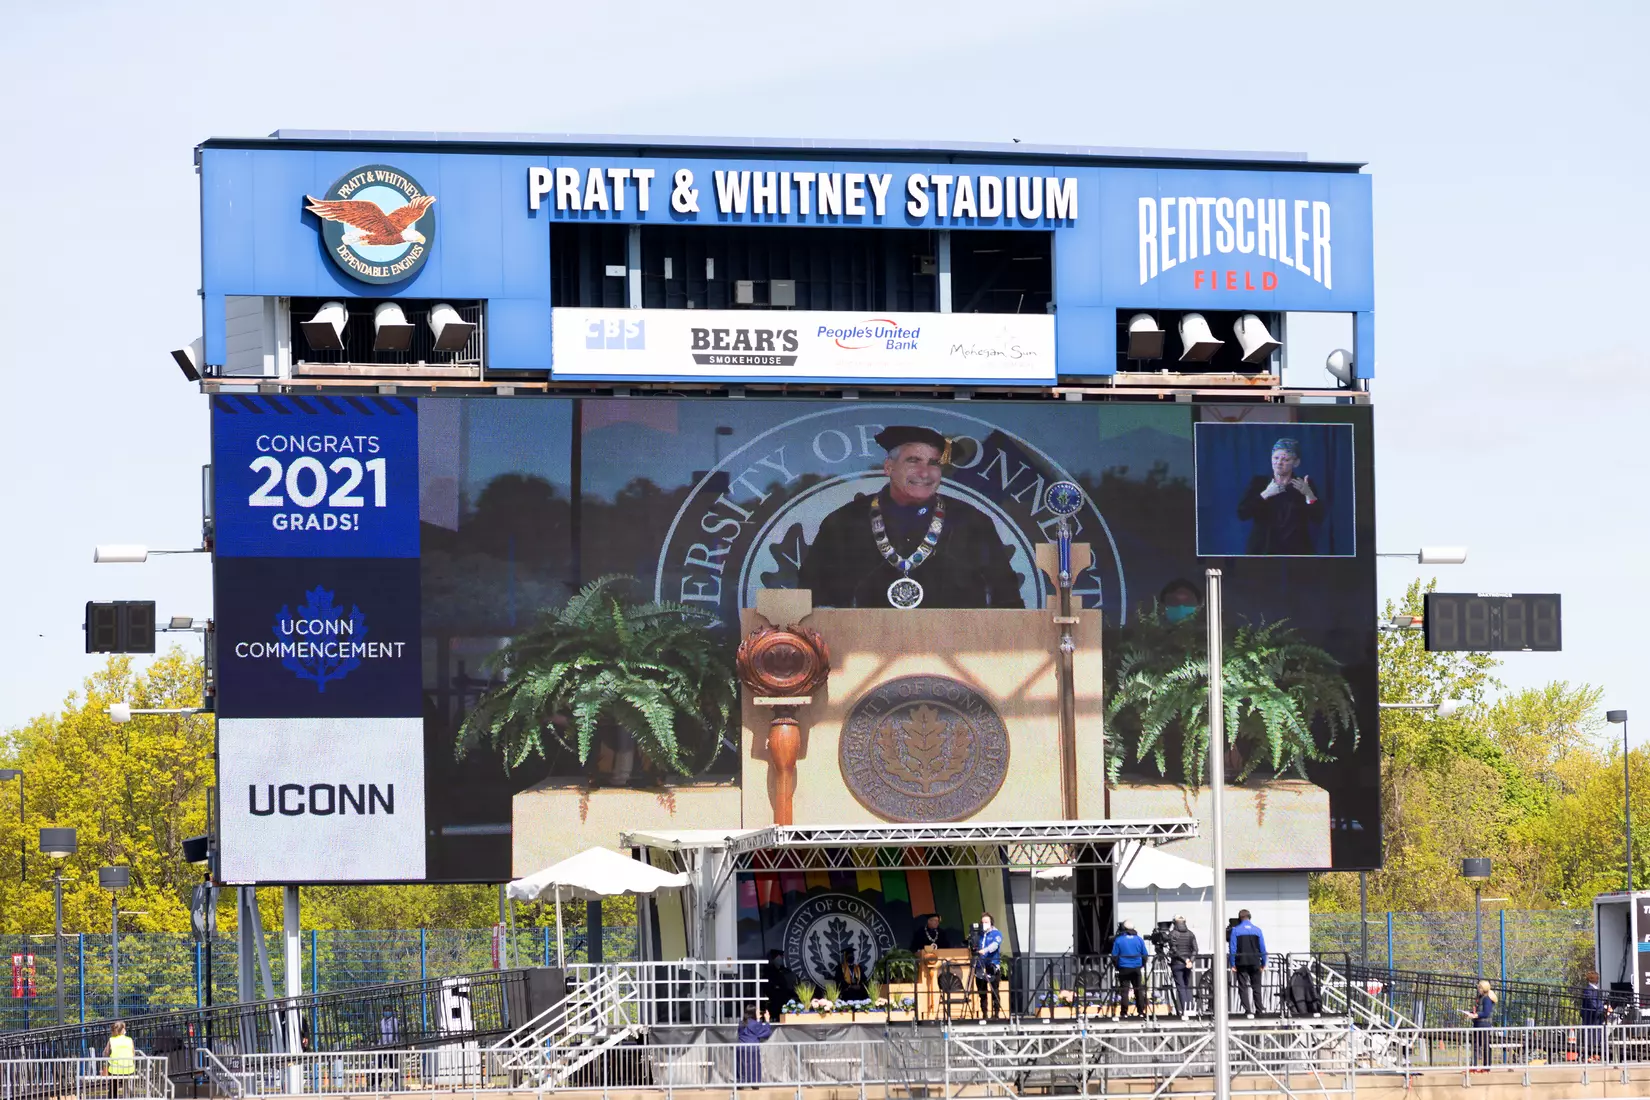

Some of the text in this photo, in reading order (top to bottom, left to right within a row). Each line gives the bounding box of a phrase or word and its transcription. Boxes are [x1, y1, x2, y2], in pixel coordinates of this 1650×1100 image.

[337, 170, 420, 201] PRATT & WHITNEY
[529, 167, 1078, 220] PRATT & WHITNEY STADIUM
[1138, 197, 1332, 290] RENTSCHLER
[336, 244, 424, 277] DEPENDABLE ENGINES
[1193, 270, 1278, 290] FIELD
[584, 319, 643, 341] CBS
[690, 328, 799, 352] BEAR'S
[817, 326, 920, 341] People's United
[886, 338, 918, 350] Bank
[1010, 345, 1038, 359] Sun
[709, 355, 782, 365] SMOKEHOUSE
[256, 435, 380, 453] CONGRATS
[248, 456, 387, 507] 2021
[272, 513, 359, 531] GRADS!
[281, 619, 354, 635] UCONN
[235, 642, 405, 658] COMMENCEMENT
[899, 682, 925, 697] OF
[249, 783, 394, 816] UCONN
[788, 907, 814, 982] NIVERSITY
[815, 900, 833, 913] OF
